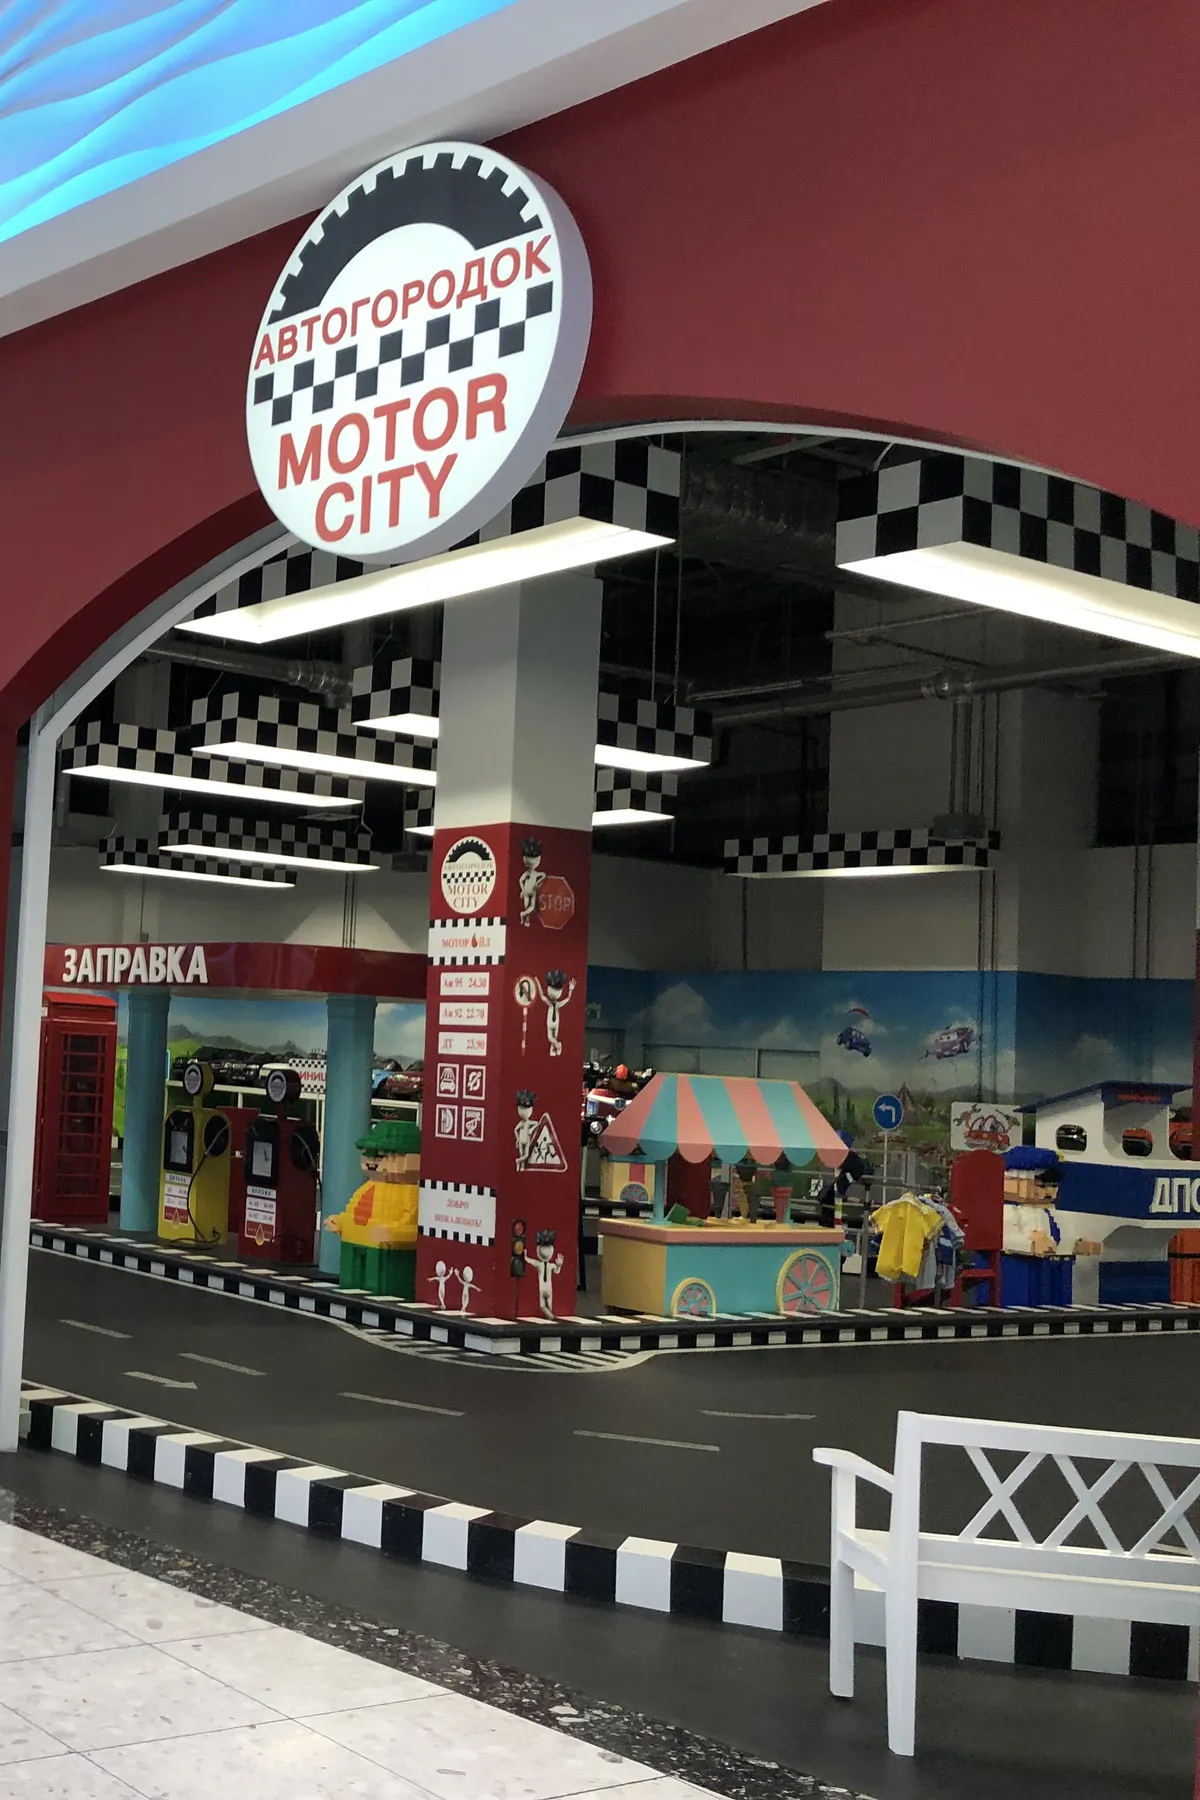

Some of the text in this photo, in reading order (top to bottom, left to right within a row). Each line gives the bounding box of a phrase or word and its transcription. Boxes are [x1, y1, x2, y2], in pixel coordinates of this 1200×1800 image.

[254, 234, 553, 371] АВТОГОРОДОК
[277, 372, 508, 490] MOTOR
[314, 453, 458, 543] CITY
[447, 883, 488, 896] MOTOR
[452, 896, 479, 909] CITY
[538, 893, 572, 912] STOP
[62, 945, 208, 984] ЗАПРАВКА
